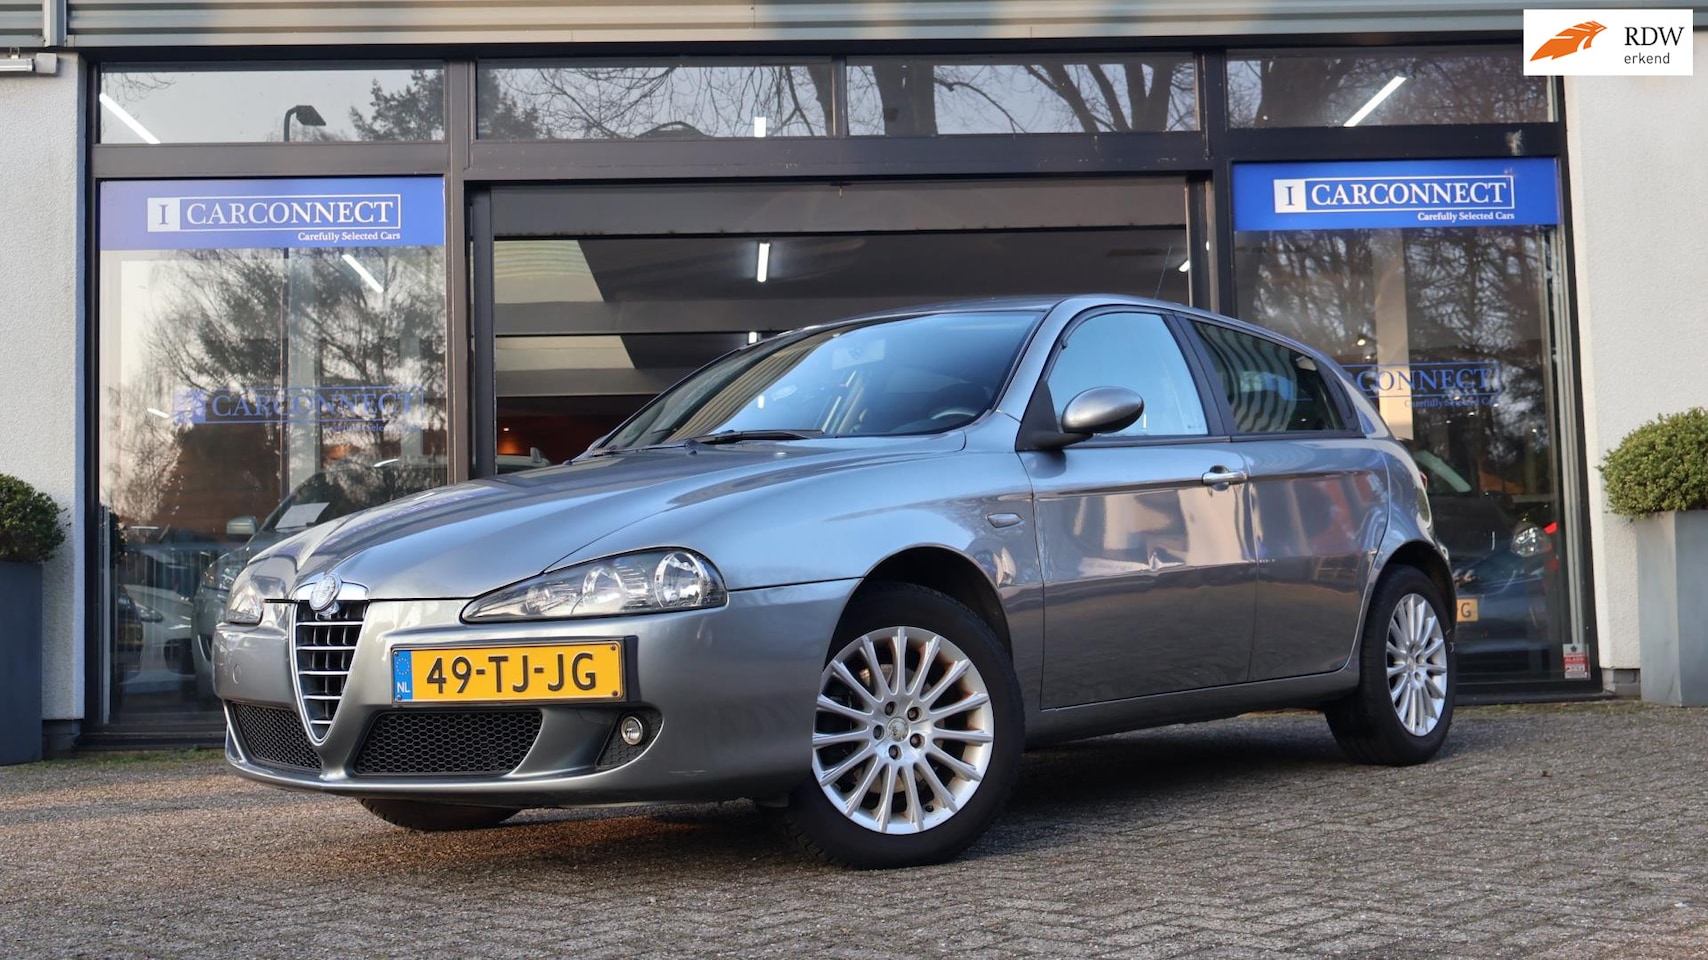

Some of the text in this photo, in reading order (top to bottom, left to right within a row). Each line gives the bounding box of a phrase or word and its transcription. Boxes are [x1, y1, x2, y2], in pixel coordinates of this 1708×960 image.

[1285, 182, 1507, 206] I CARCONNECT
[158, 200, 394, 225] I CARCONNECT
[1417, 211, 1515, 223] Carefully Selected Cars
[297, 231, 401, 244] Carefully Selected Cars
[426, 652, 596, 694] 49-TJ-JG
[396, 681, 411, 693] NL
